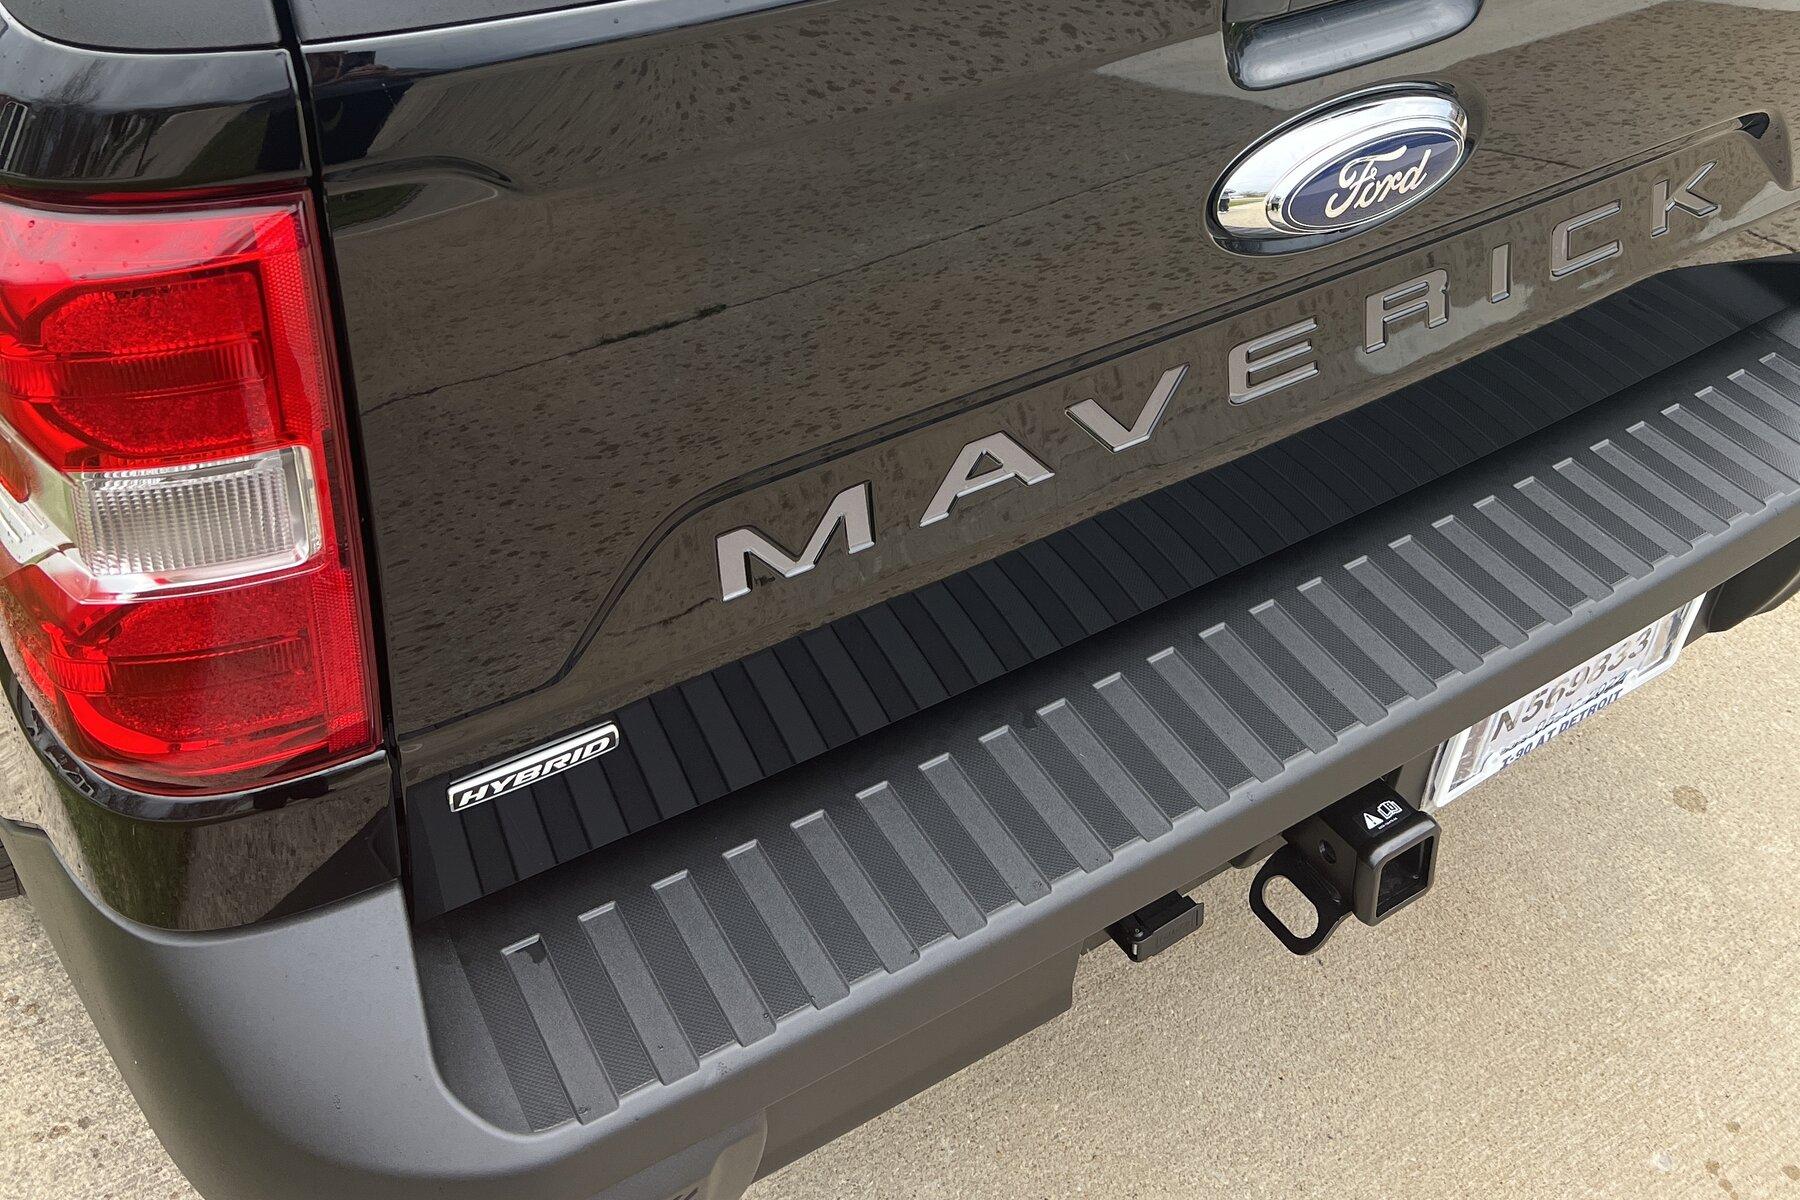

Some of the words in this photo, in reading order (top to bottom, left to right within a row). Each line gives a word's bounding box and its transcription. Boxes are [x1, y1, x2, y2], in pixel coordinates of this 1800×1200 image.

[1324, 145, 1432, 218] Ford
[714, 161, 1722, 601] MAVERICK
[1536, 727, 1557, 750] AT
[1558, 688, 1624, 735] DETROIT
[458, 736, 611, 807] HYBRID
